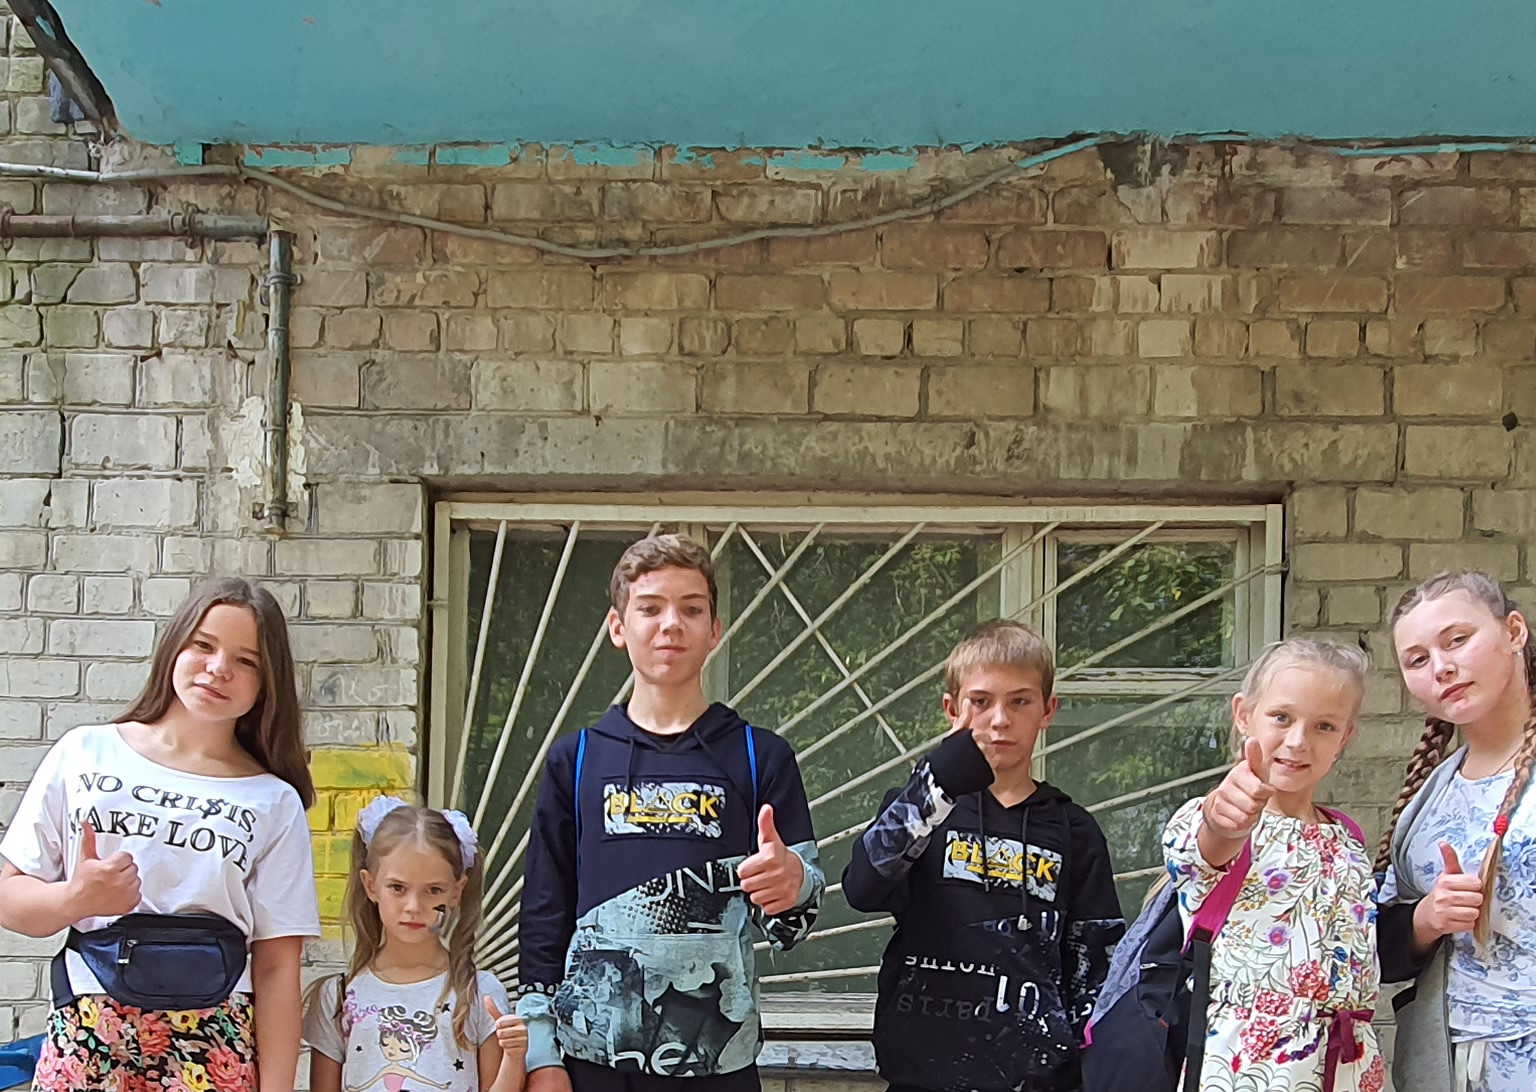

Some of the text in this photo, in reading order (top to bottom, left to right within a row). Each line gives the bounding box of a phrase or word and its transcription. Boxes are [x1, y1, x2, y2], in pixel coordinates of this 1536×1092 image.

[77, 772, 124, 794] NO
[609, 791, 719, 819] BLACK
[950, 838, 1058, 882] BLACK
